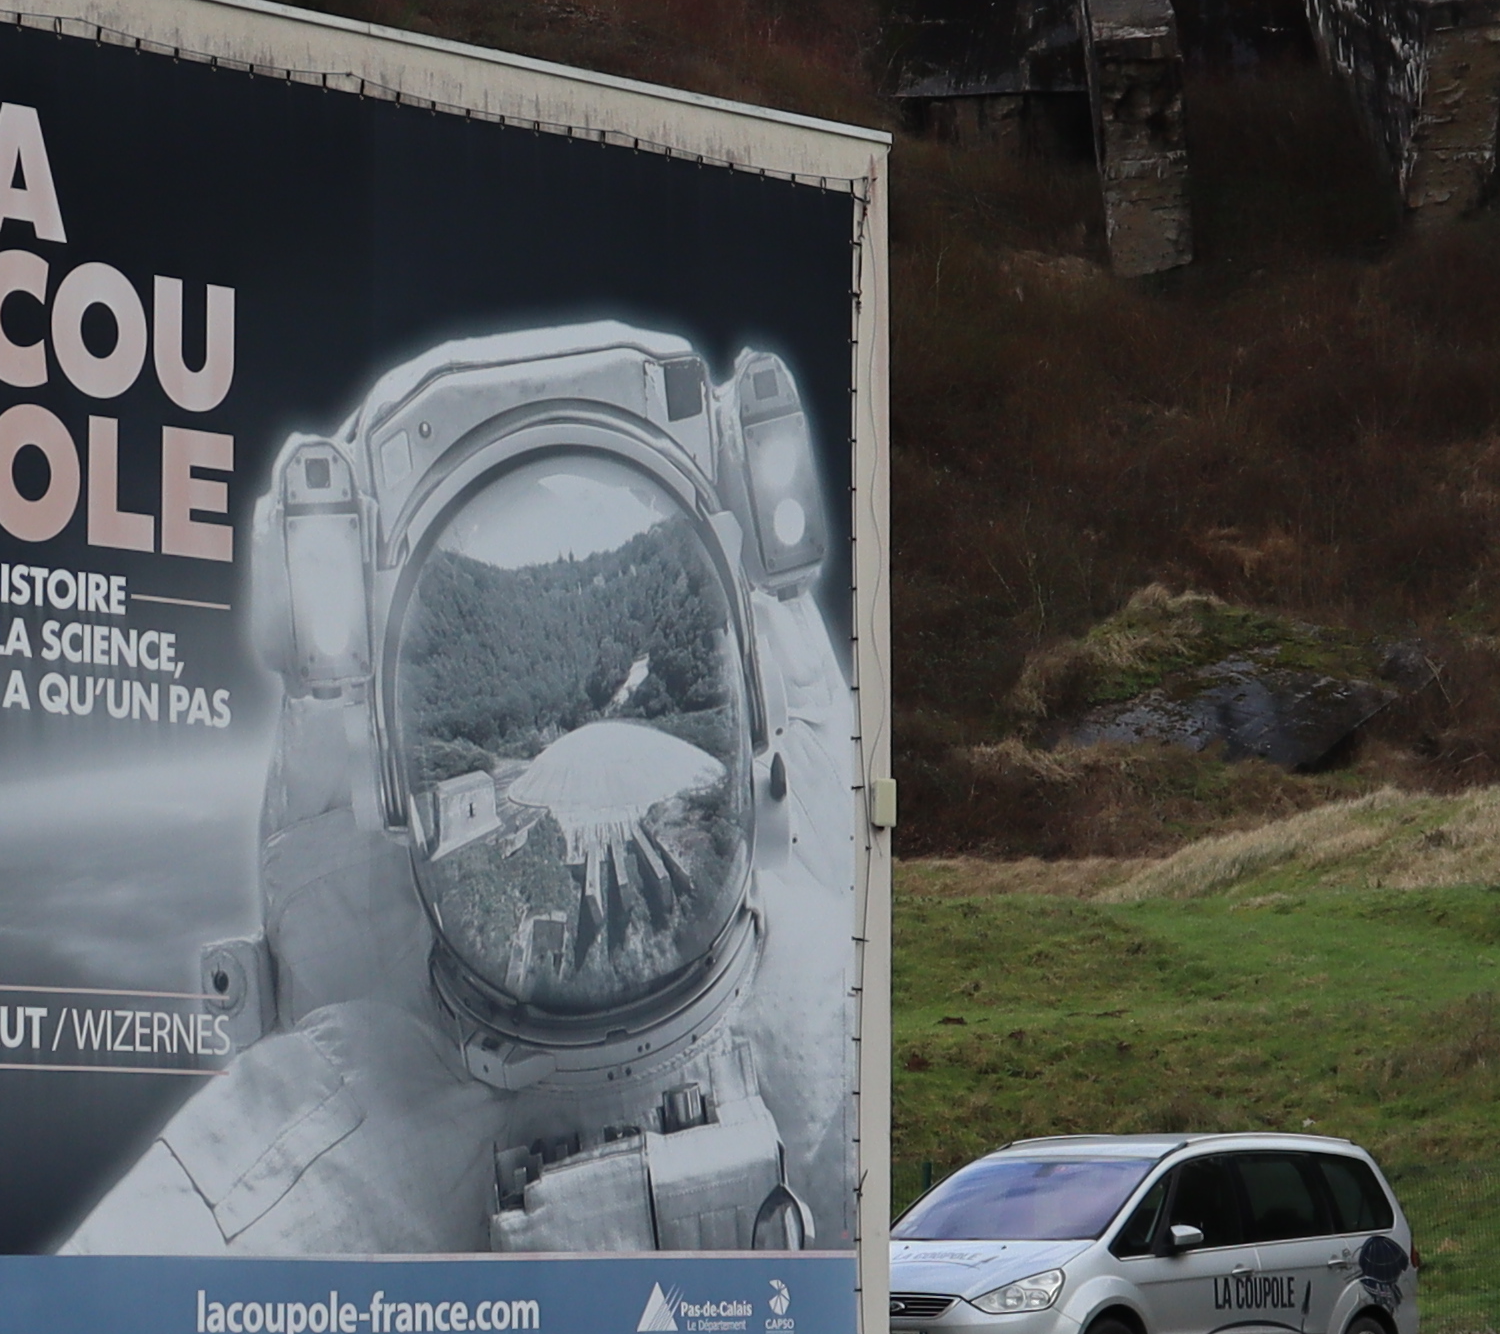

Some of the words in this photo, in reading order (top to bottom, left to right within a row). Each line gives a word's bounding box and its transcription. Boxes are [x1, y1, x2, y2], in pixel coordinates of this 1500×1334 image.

[41, 620, 185, 679] SCIENCE,
[2, 670, 31, 711] A
[38, 672, 159, 722] QU'UN
[169, 684, 232, 729] PAS
[71, 1008, 231, 1056] WIZERNES
[680, 1300, 753, 1317] Pas-de-Calais
[1214, 1277, 1232, 1309] LA
[1236, 1276, 1295, 1309] COUPOLE
[687, 1320, 697, 1331] Le
[698, 1319, 747, 1334] Département
[765, 1318, 795, 1329] CAPSO
